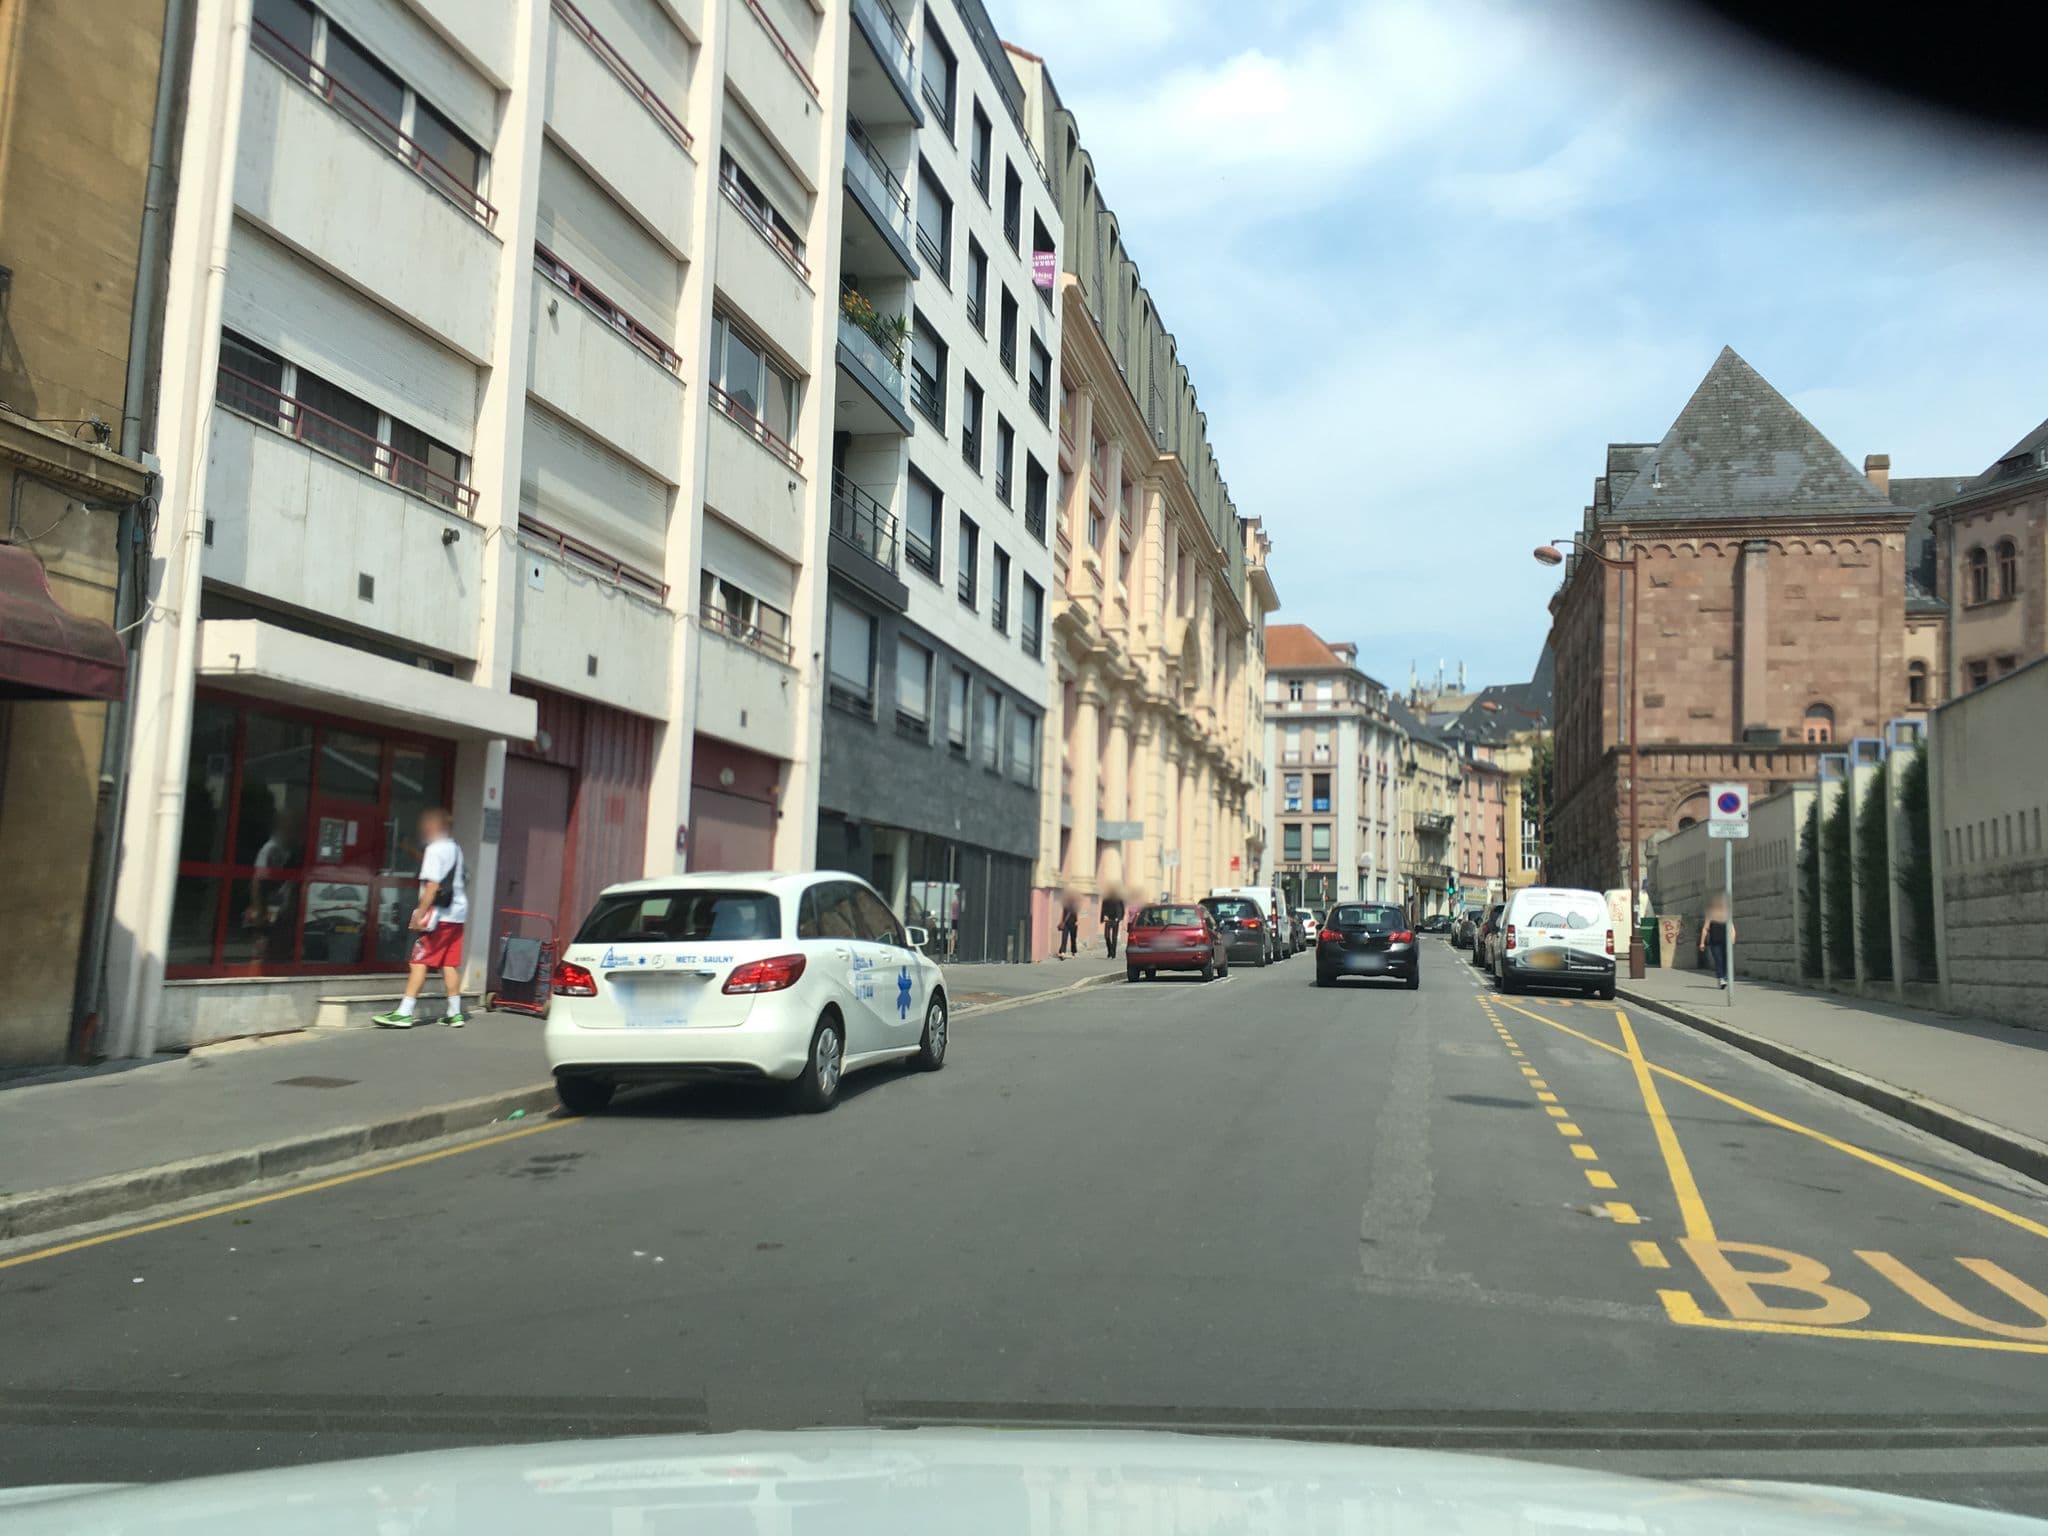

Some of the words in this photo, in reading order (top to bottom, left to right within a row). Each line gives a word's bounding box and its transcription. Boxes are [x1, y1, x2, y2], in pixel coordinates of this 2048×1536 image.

[676, 955, 697, 963] METZ
[703, 955, 734, 963] SAULNY
[1676, 1237, 2048, 1342] BU
